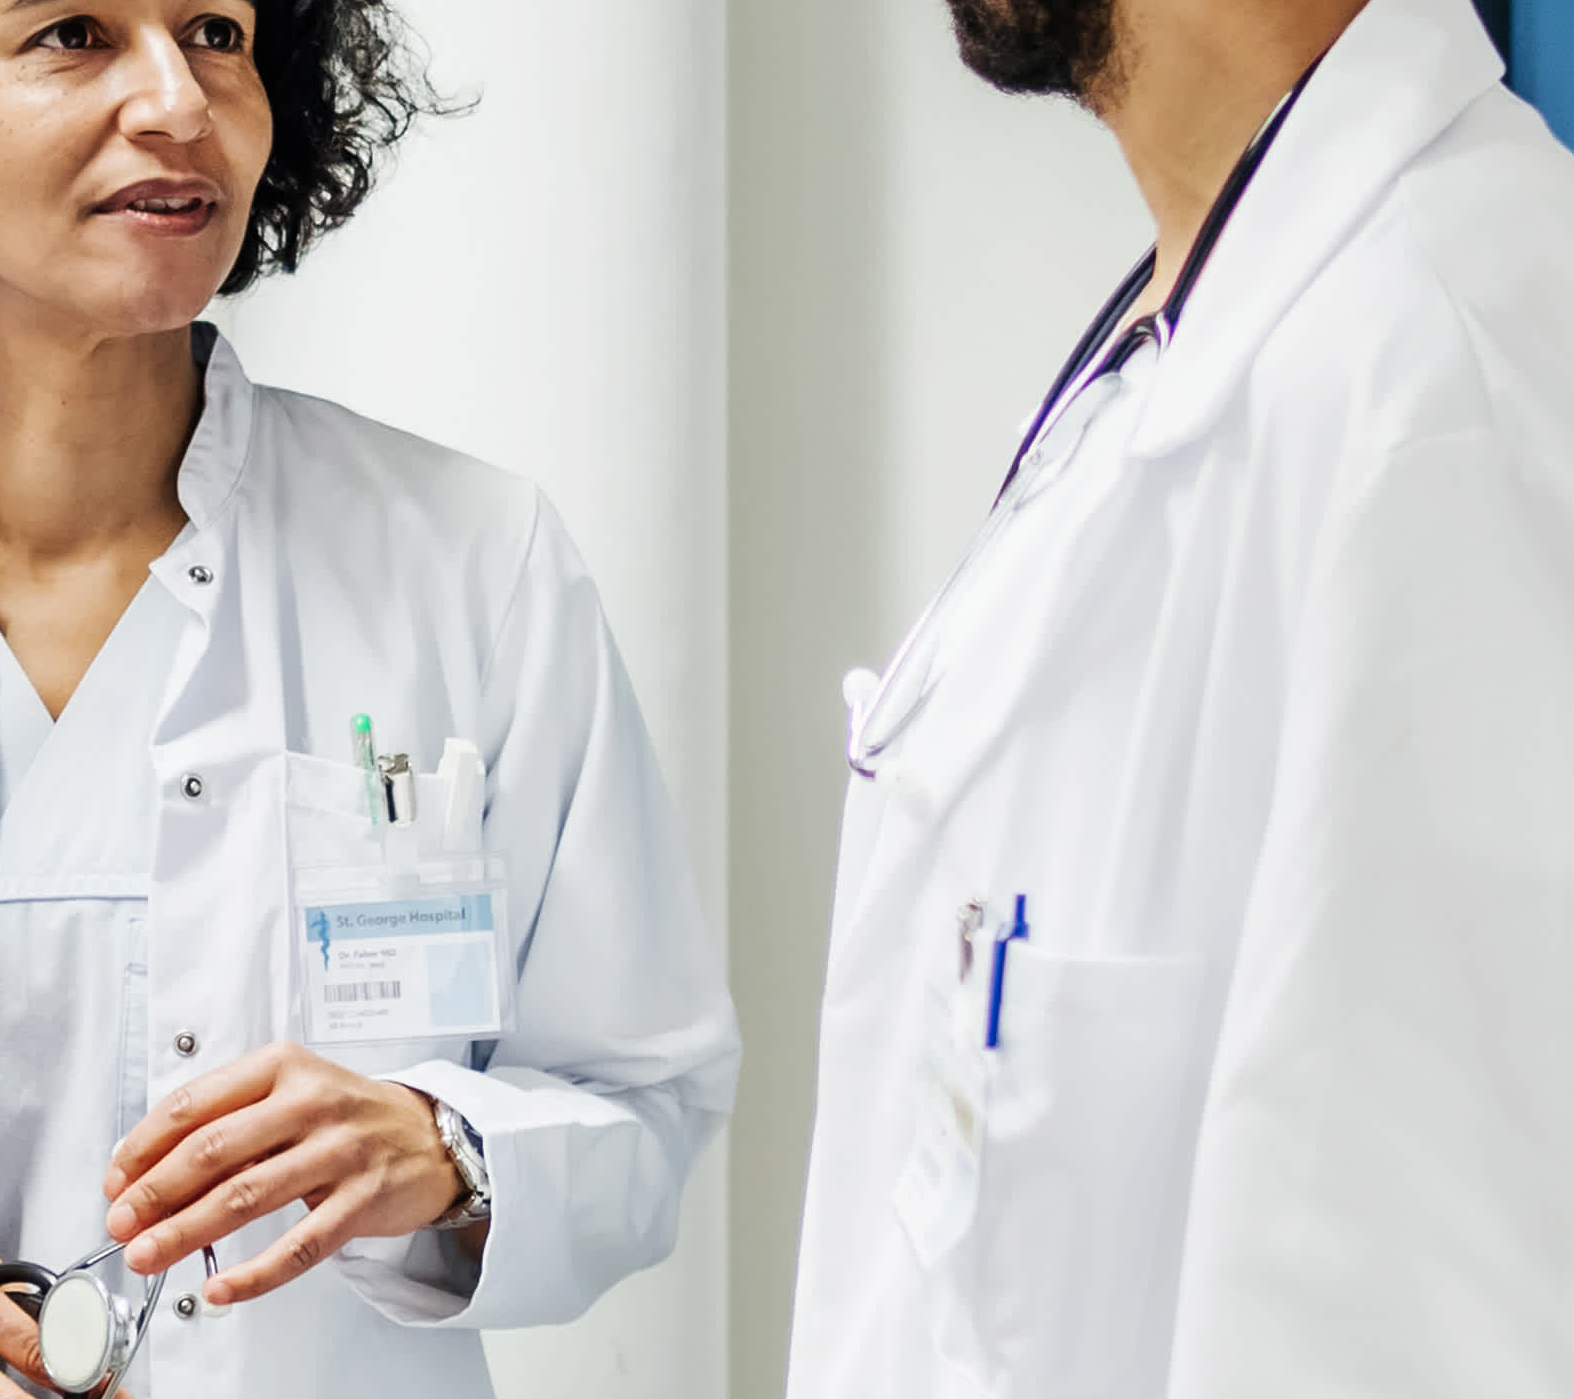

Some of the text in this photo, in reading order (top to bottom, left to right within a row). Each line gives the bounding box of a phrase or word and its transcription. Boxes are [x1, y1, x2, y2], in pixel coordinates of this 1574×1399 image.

[336, 906, 466, 928] St. George Hospital
